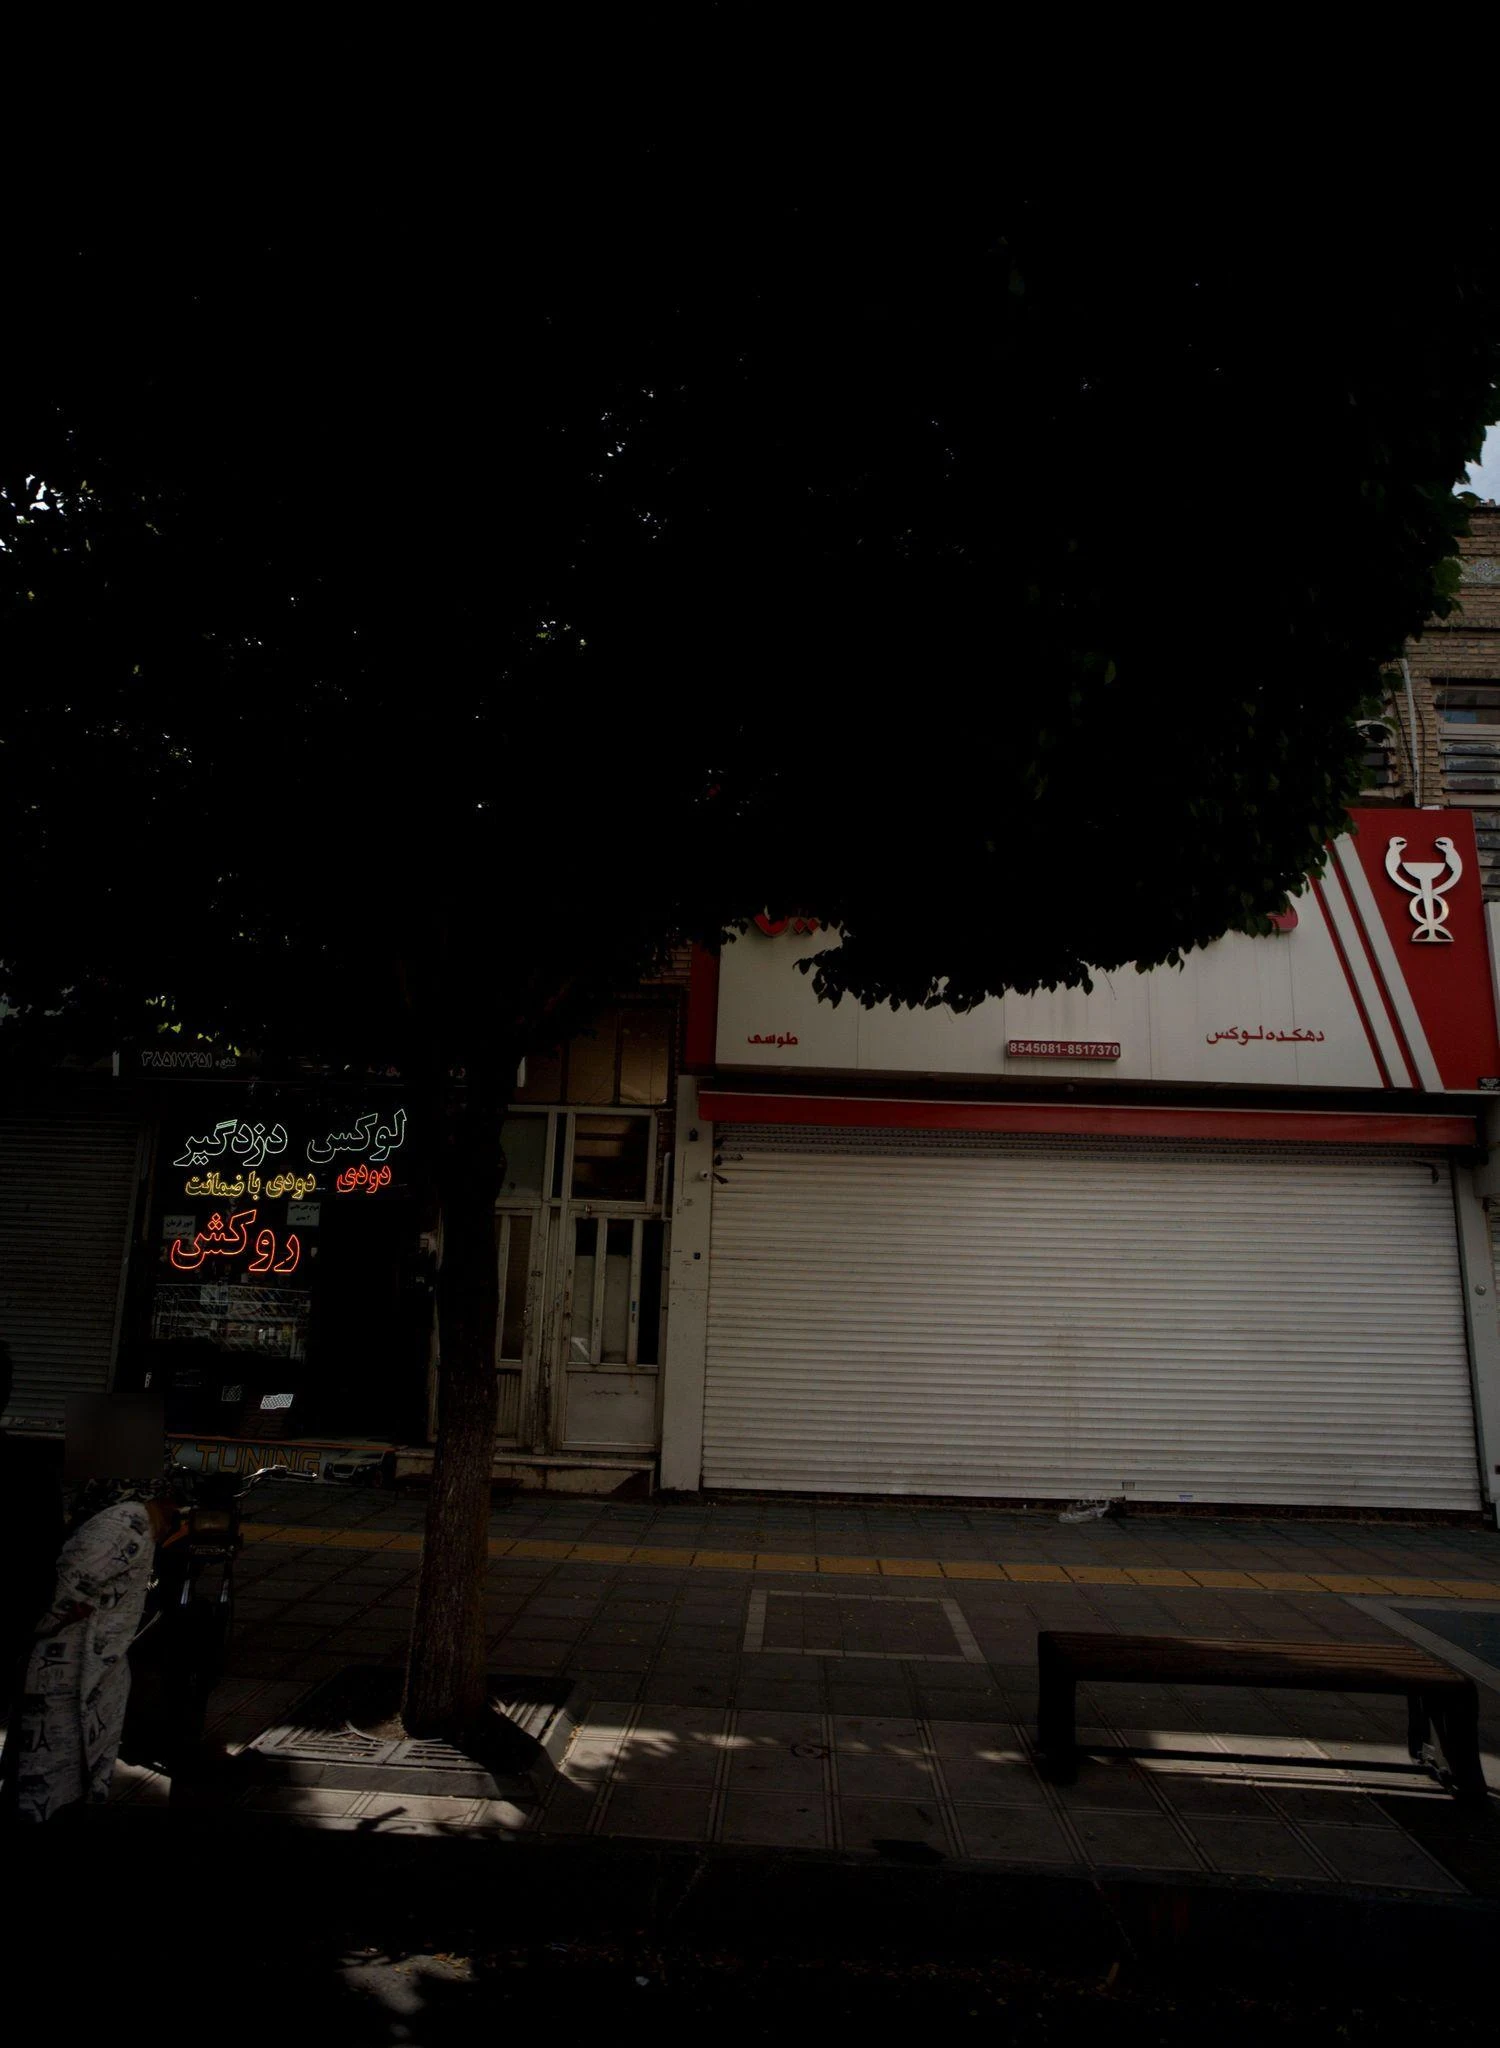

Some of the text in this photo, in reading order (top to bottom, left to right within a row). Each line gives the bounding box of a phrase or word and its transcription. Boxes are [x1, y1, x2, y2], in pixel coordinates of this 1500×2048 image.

[747, 1031, 799, 1049] طوسی
[1009, 1042, 1120, 1056] 8545081-8517370
[1206, 1025, 1324, 1046] دهکده لوکس
[173, 1109, 408, 1167] لوکس دزدگیر
[185, 1171, 316, 1200] دودی با ضمانت
[336, 1164, 392, 1194] دودی
[170, 1209, 301, 1272] روکش
[196, 1443, 321, 1474] TUNING
